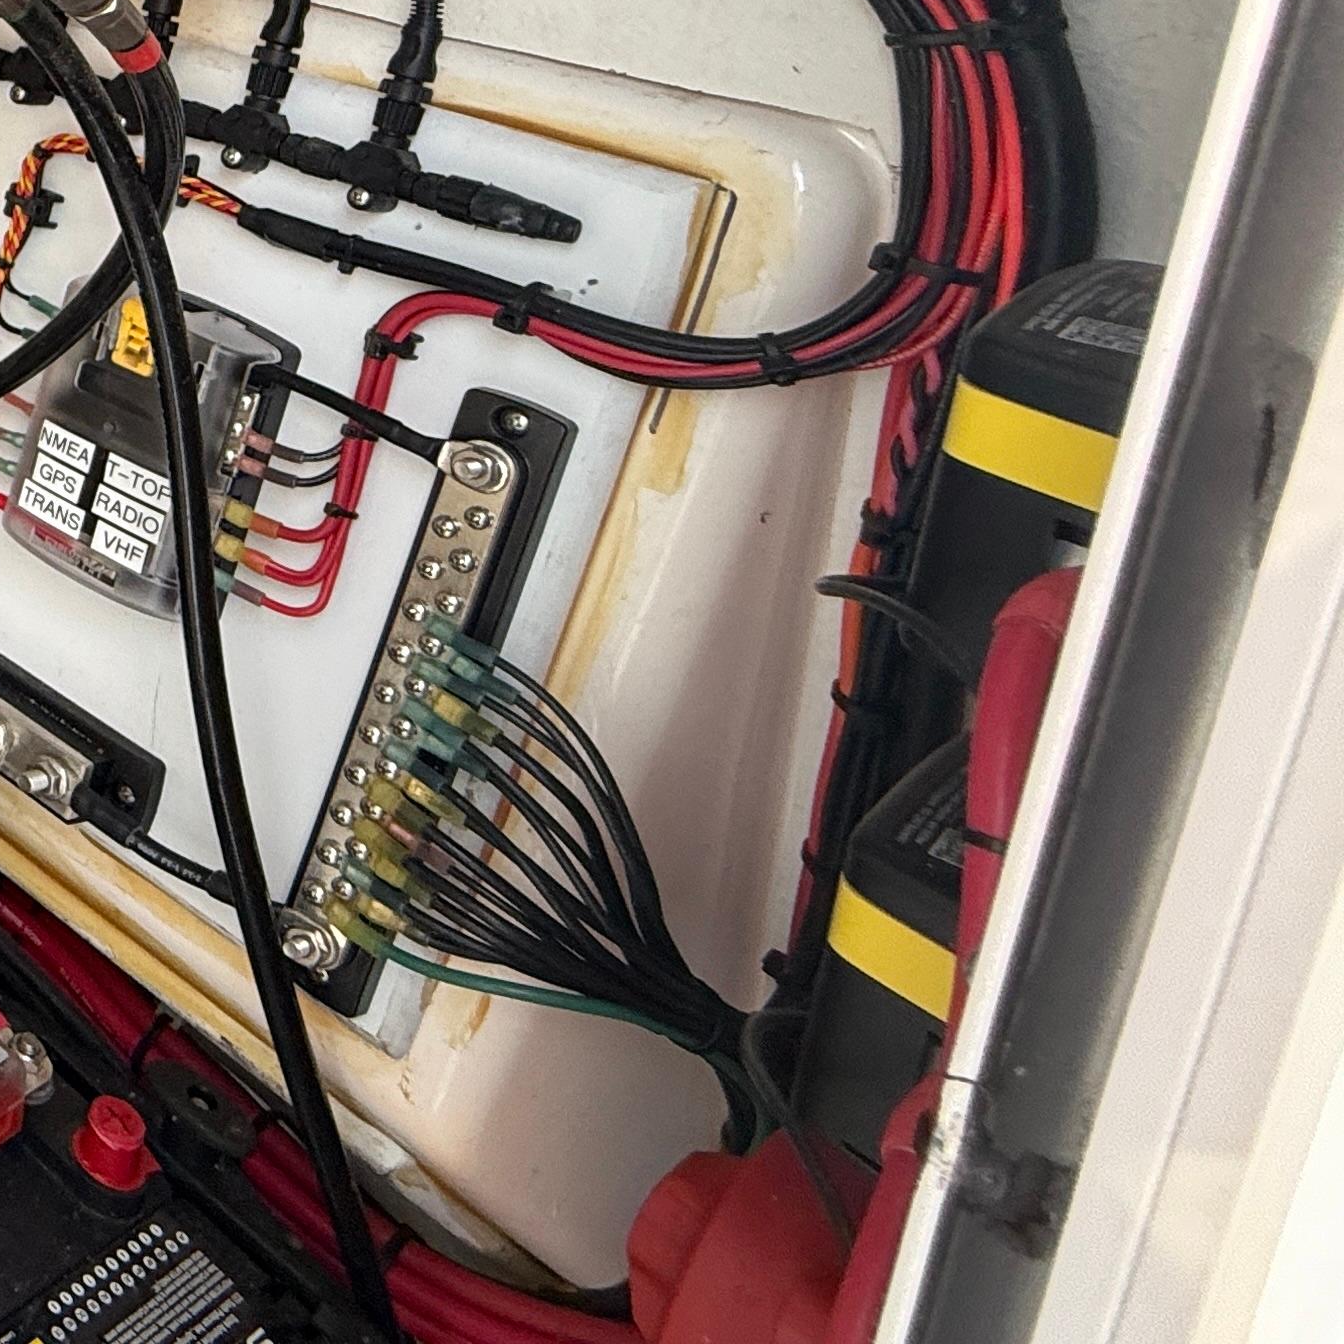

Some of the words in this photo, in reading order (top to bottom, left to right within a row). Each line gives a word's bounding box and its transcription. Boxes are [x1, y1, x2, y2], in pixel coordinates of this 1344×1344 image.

[41, 427, 89, 465] NMEA
[40, 464, 76, 494] GPS
[25, 486, 81, 531] TRANS
[96, 492, 159, 535] RADIO
[105, 531, 144, 561] VHF
